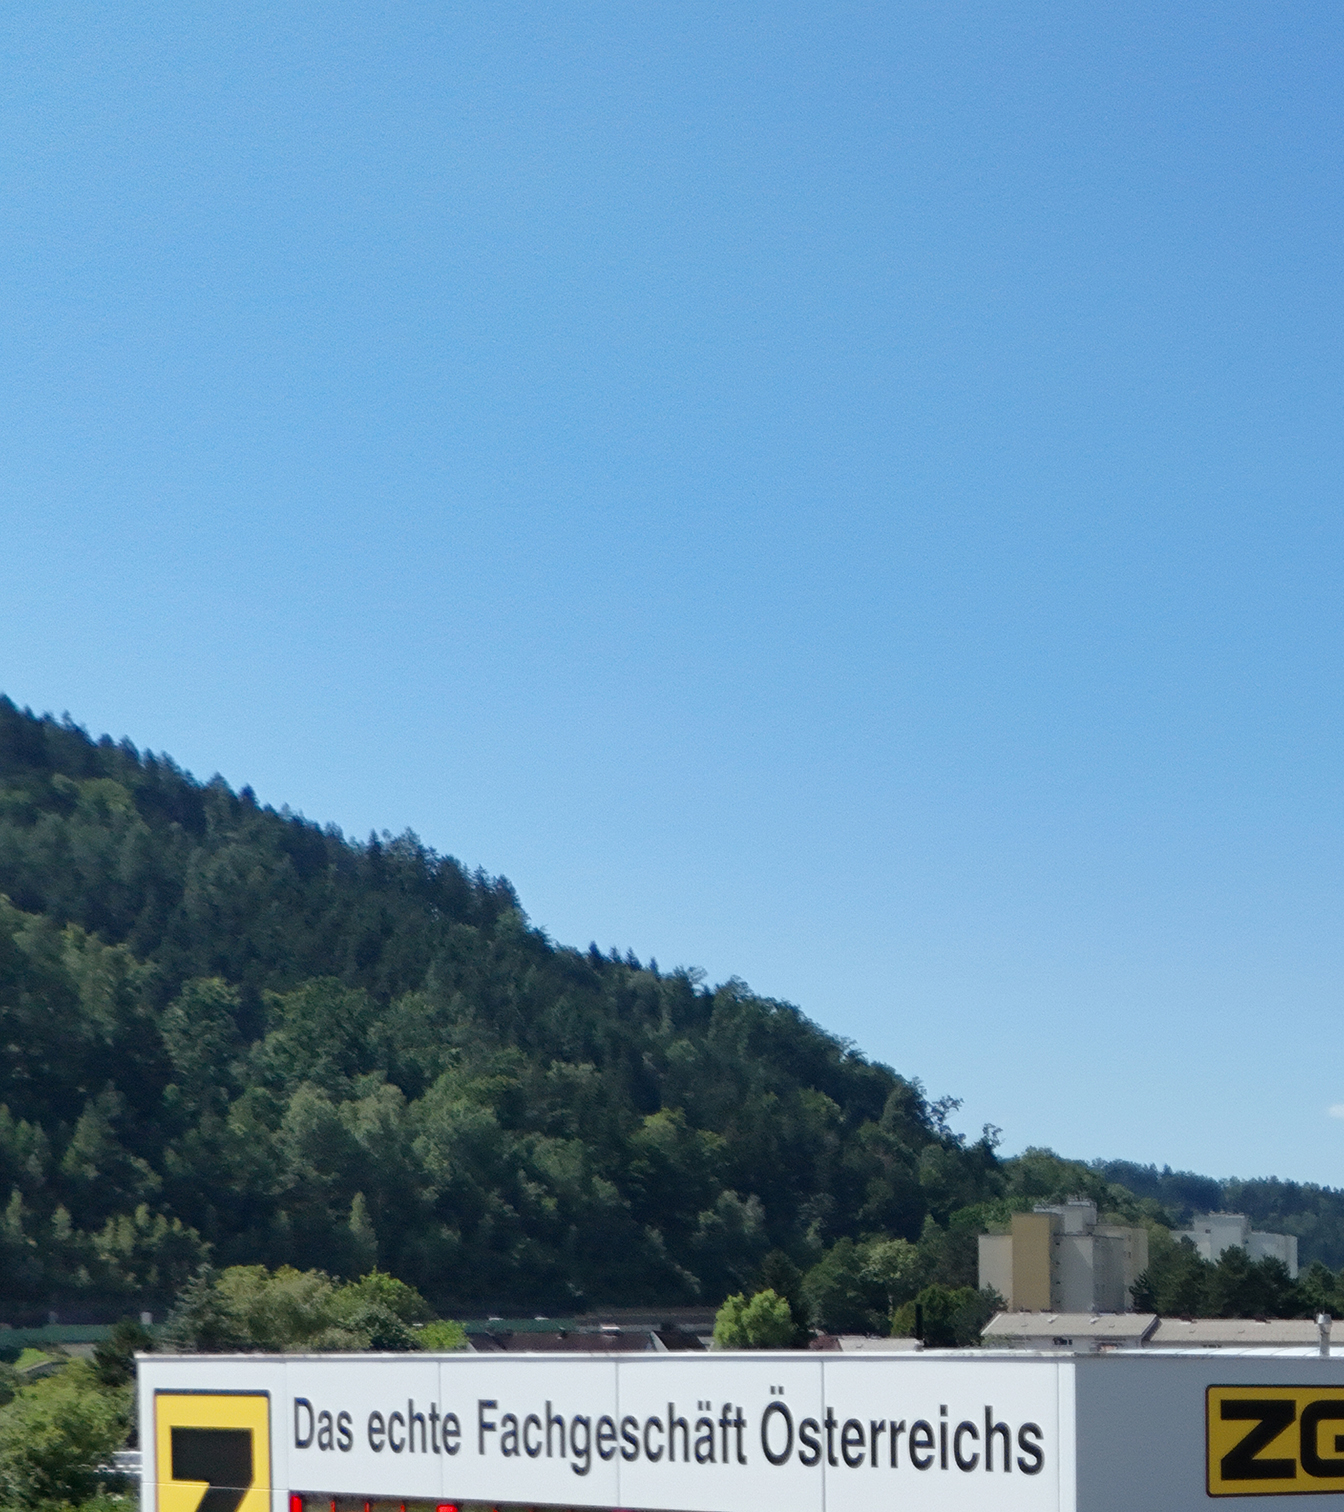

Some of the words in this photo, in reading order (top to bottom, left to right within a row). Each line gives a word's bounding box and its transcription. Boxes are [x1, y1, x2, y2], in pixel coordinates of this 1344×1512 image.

[294, 1397, 354, 1452] Das
[367, 1399, 461, 1455] echte
[477, 1399, 748, 1476] Fachgeschäft
[760, 1385, 1045, 1476] Österreichs
